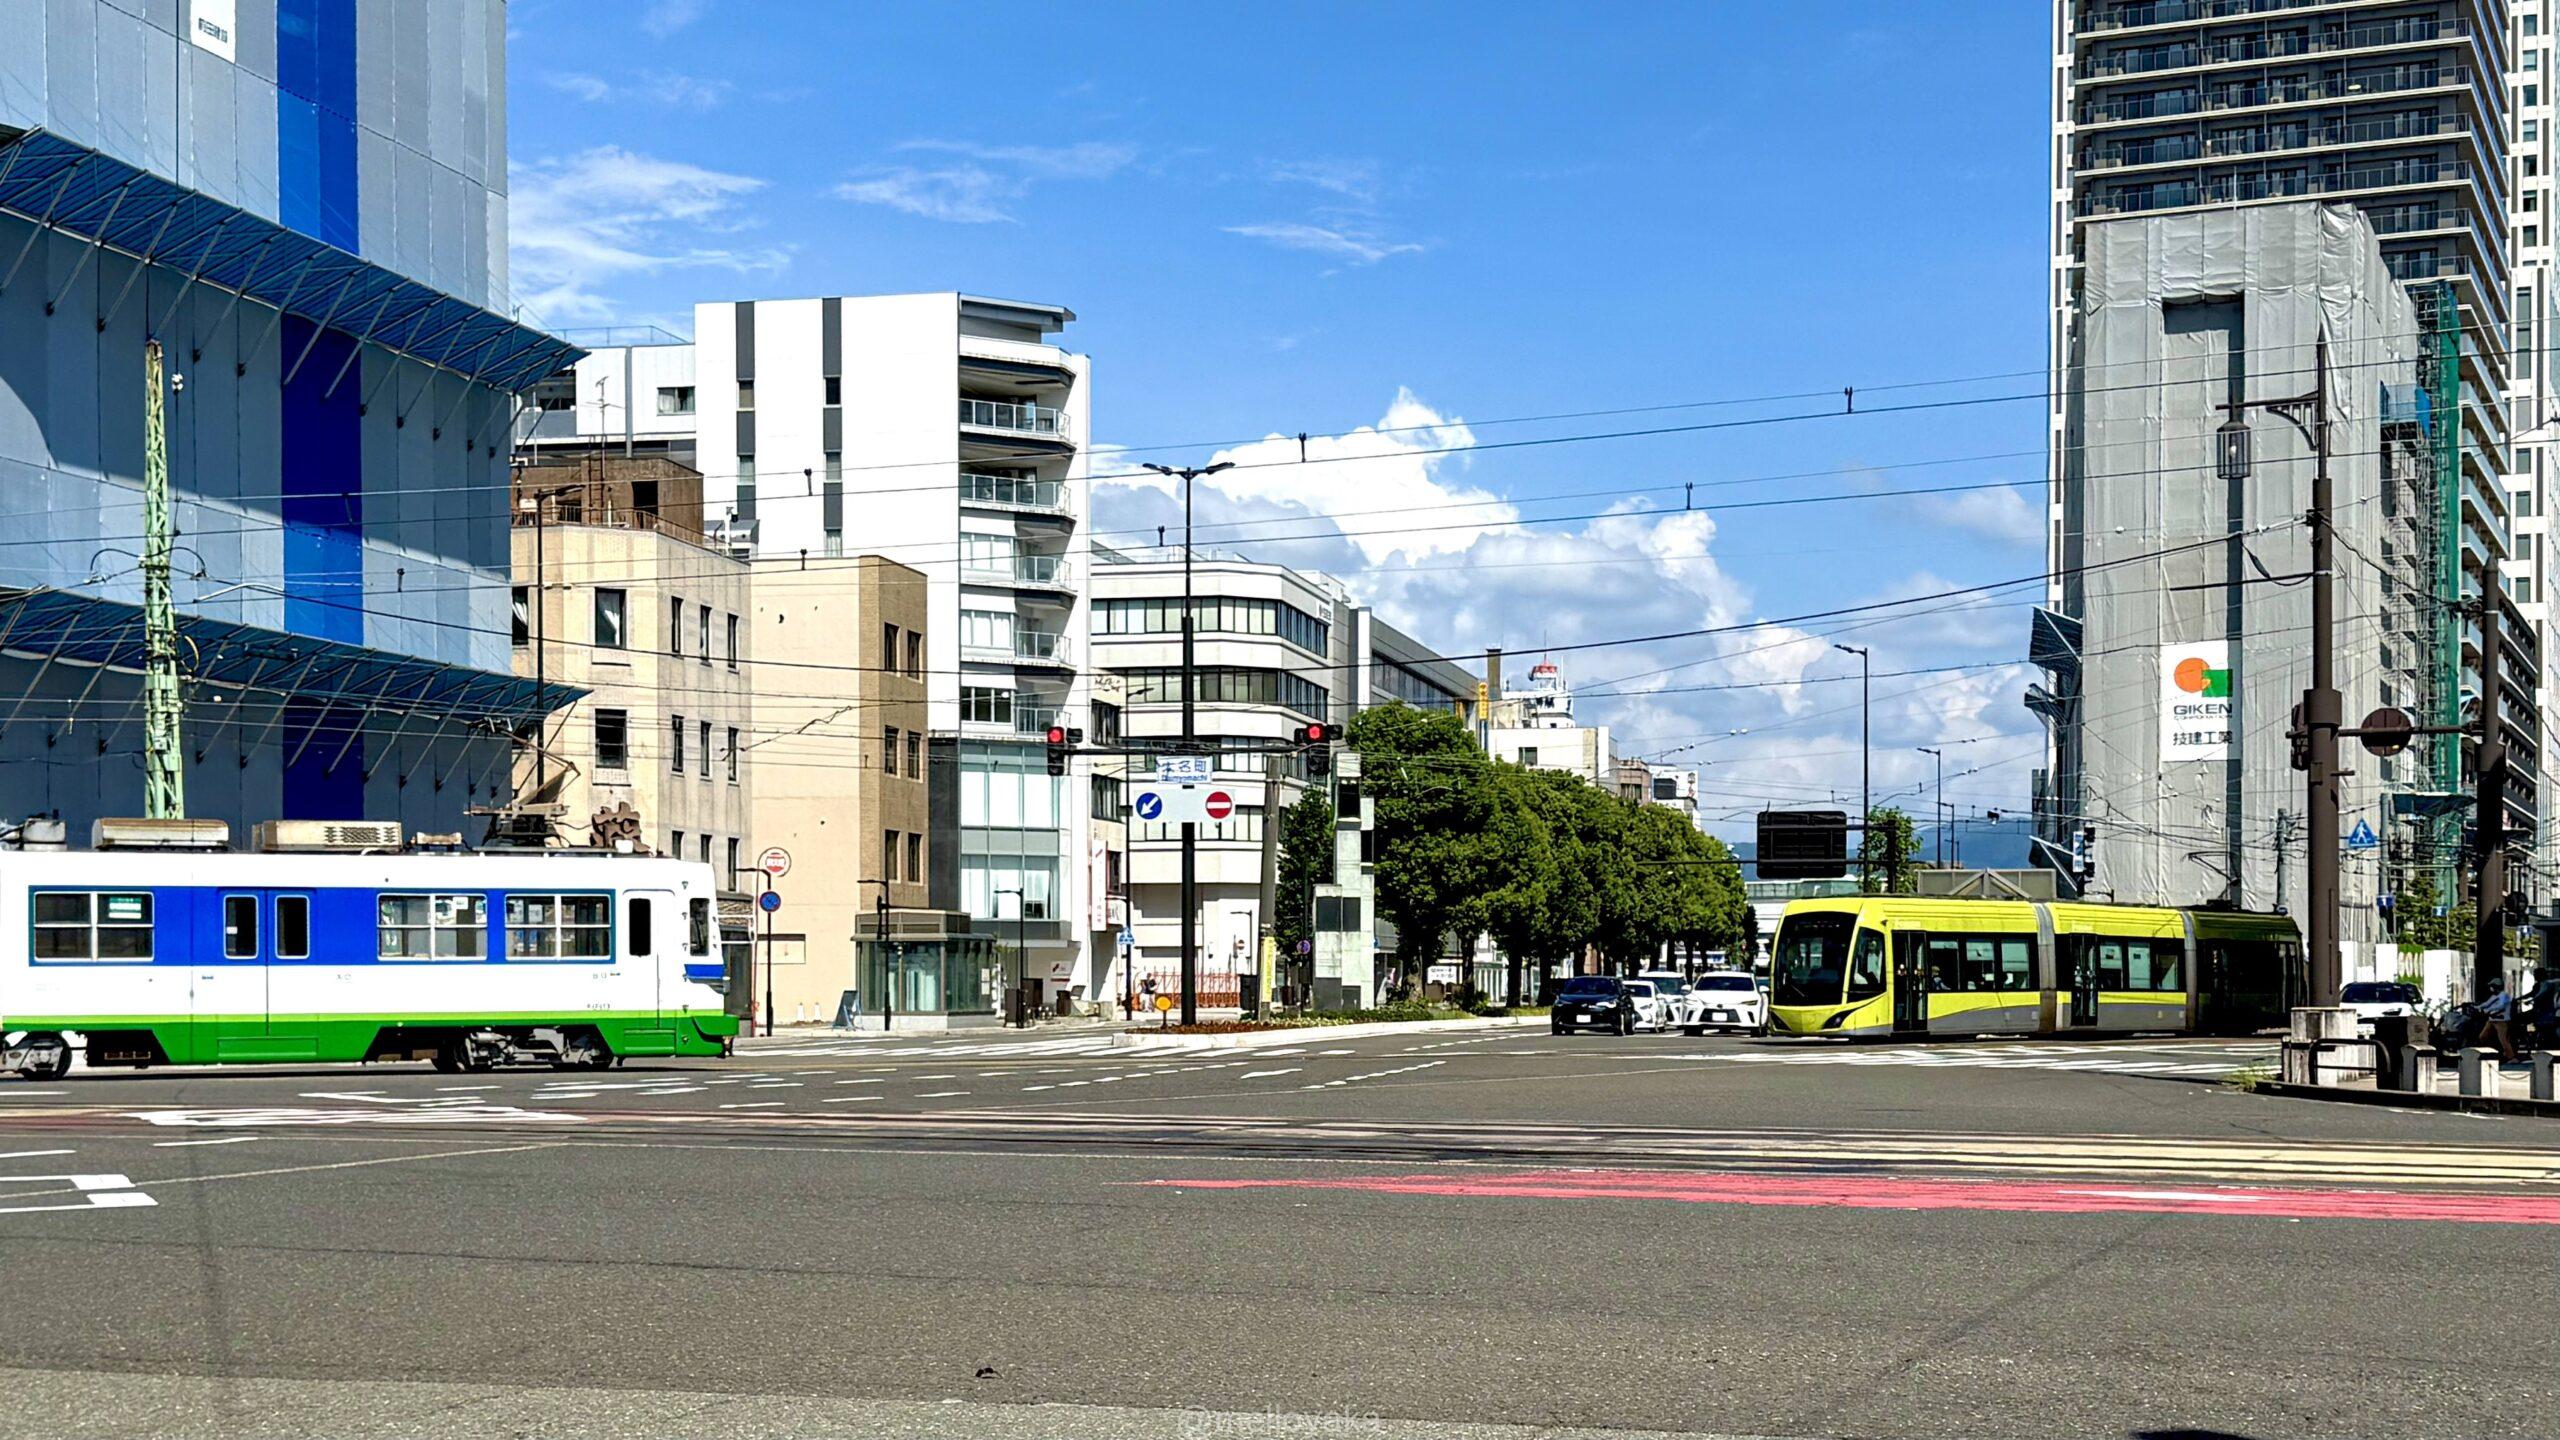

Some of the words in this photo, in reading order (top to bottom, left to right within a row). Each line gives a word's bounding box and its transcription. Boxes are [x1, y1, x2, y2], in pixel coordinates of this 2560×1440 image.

[2173, 703, 2233, 715] GIKEN
[2172, 730, 2234, 746] 技建工業
